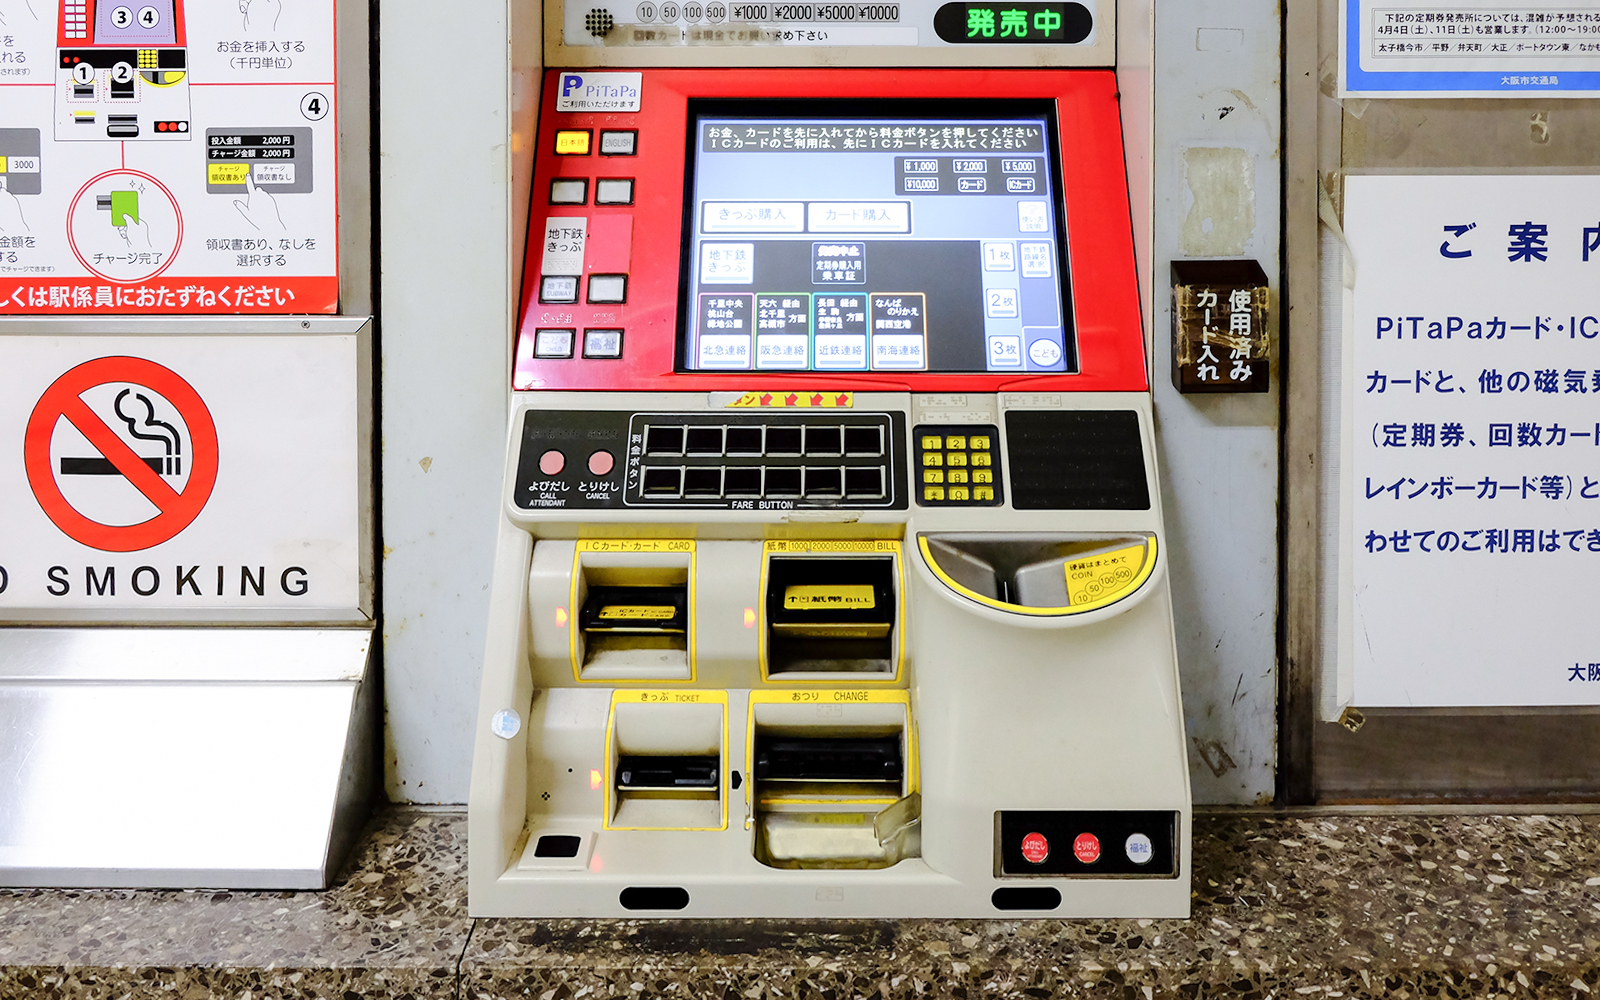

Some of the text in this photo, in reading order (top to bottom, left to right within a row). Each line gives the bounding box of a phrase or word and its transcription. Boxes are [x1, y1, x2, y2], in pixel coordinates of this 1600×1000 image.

[642, 7, 653, 18] 10
[664, 7, 676, 18] 50
[685, 7, 702, 18] 100
[707, 7, 725, 18] 500
[734, 5, 768, 20] ¥1000
[775, 5, 812, 20] ¥2000
[817, 5, 855, 20] ¥5000
[859, 5, 899, 20] ¥10000
[967, 8, 1061, 38] 発売中
[0, 34, 14, 47] を
[217, 40, 306, 54] お金を挿入する
[0, 51, 26, 63] れる
[230, 57, 293, 70] （千円単位）
[1500, 76, 1559, 86] 大阪市交通局
[586, 86, 637, 98] PiTaPa
[562, 100, 635, 109] ご利用いただけます
[708, 127, 1039, 139] お金、カードを先に入れてから料金ボタンを押してください
[560, 138, 585, 147] 日本語
[605, 138, 631, 148] ENGLISH
[15, 160, 34, 169] 3000
[719, 207, 787, 222] きっぷ購入
[825, 208, 891, 222] カード購入
[548, 228, 584, 240] 地下鉄
[207, 237, 317, 252] 領収書あり、なしを
[548, 241, 582, 253] きっぷ
[94, 251, 163, 266] チャージ完了
[237, 253, 287, 267] 選択する
[710, 249, 747, 261] 地下鉄
[709, 261, 746, 273] きっぷ
[1196, 289, 1220, 382] カード入れ
[1228, 289, 1253, 382] 使用済み
[876, 345, 921, 356] 南海連絡
[1032, 348, 1059, 359] こども
[528, 481, 570, 492] よびだし
[578, 481, 620, 492] とりけし
[540, 492, 557, 500] CALL
[586, 492, 611, 500] CANCEL
[529, 499, 566, 507] ATTENDANT
[732, 501, 794, 510] FARE BUTTON
[668, 541, 691, 551] CARD
[792, 541, 809, 550] 1000
[813, 541, 831, 550] 2000
[835, 541, 852, 550] 5000
[878, 541, 897, 550] BILL
[1071, 571, 1094, 581] COIN
[1115, 570, 1130, 579] 500
[47, 566, 310, 597] SMOKING
[1100, 576, 1115, 585] 100
[1089, 584, 1100, 593] 50
[1078, 595, 1088, 603] 10
[641, 693, 669, 702] きっぷ
[792, 692, 869, 701] おつり CHANGE
[1130, 843, 1148, 853] 福祉
